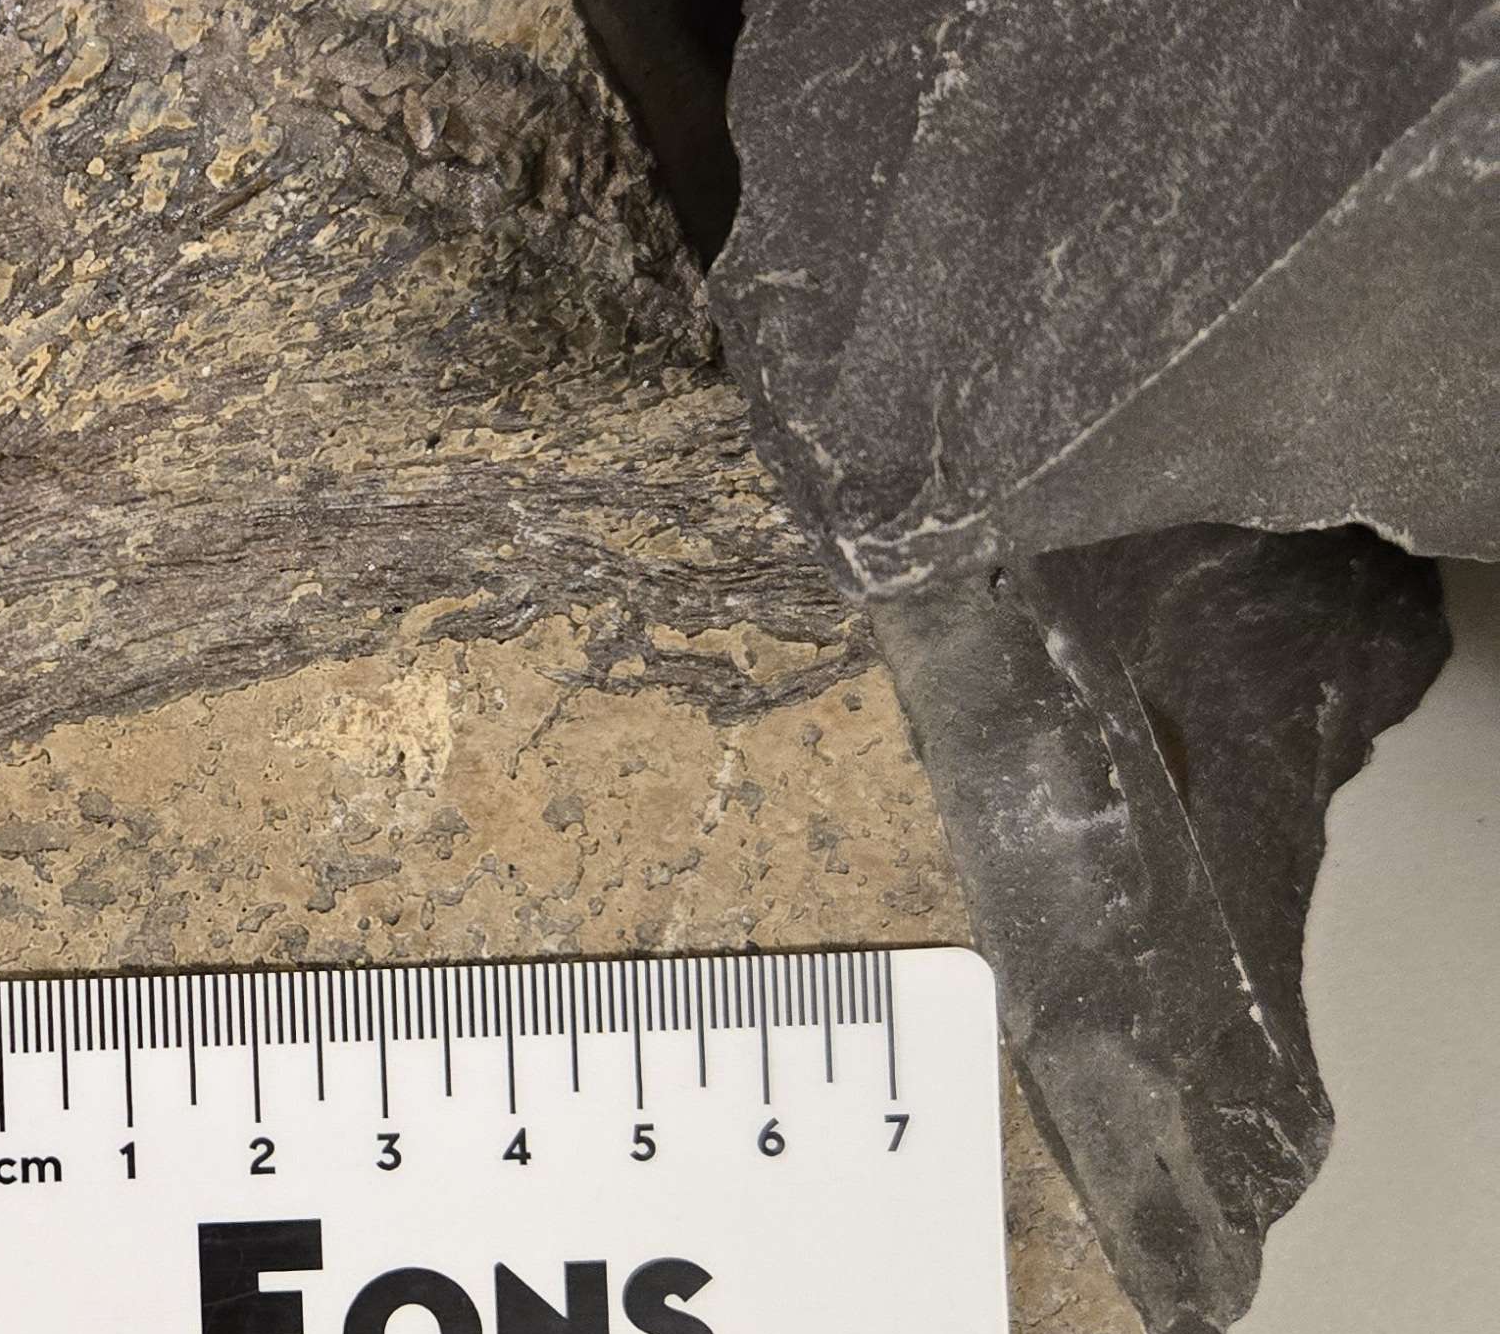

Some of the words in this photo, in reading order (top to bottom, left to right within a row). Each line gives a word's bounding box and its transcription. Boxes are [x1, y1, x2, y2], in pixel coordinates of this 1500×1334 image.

[118, 1141, 137, 1181] 1
[248, 1137, 277, 1176] 2
[375, 1132, 403, 1172] 3
[501, 1127, 533, 1167] 4
[630, 1122, 657, 1163] 5
[757, 1117, 786, 1158] 6
[884, 1113, 911, 1153] 7
